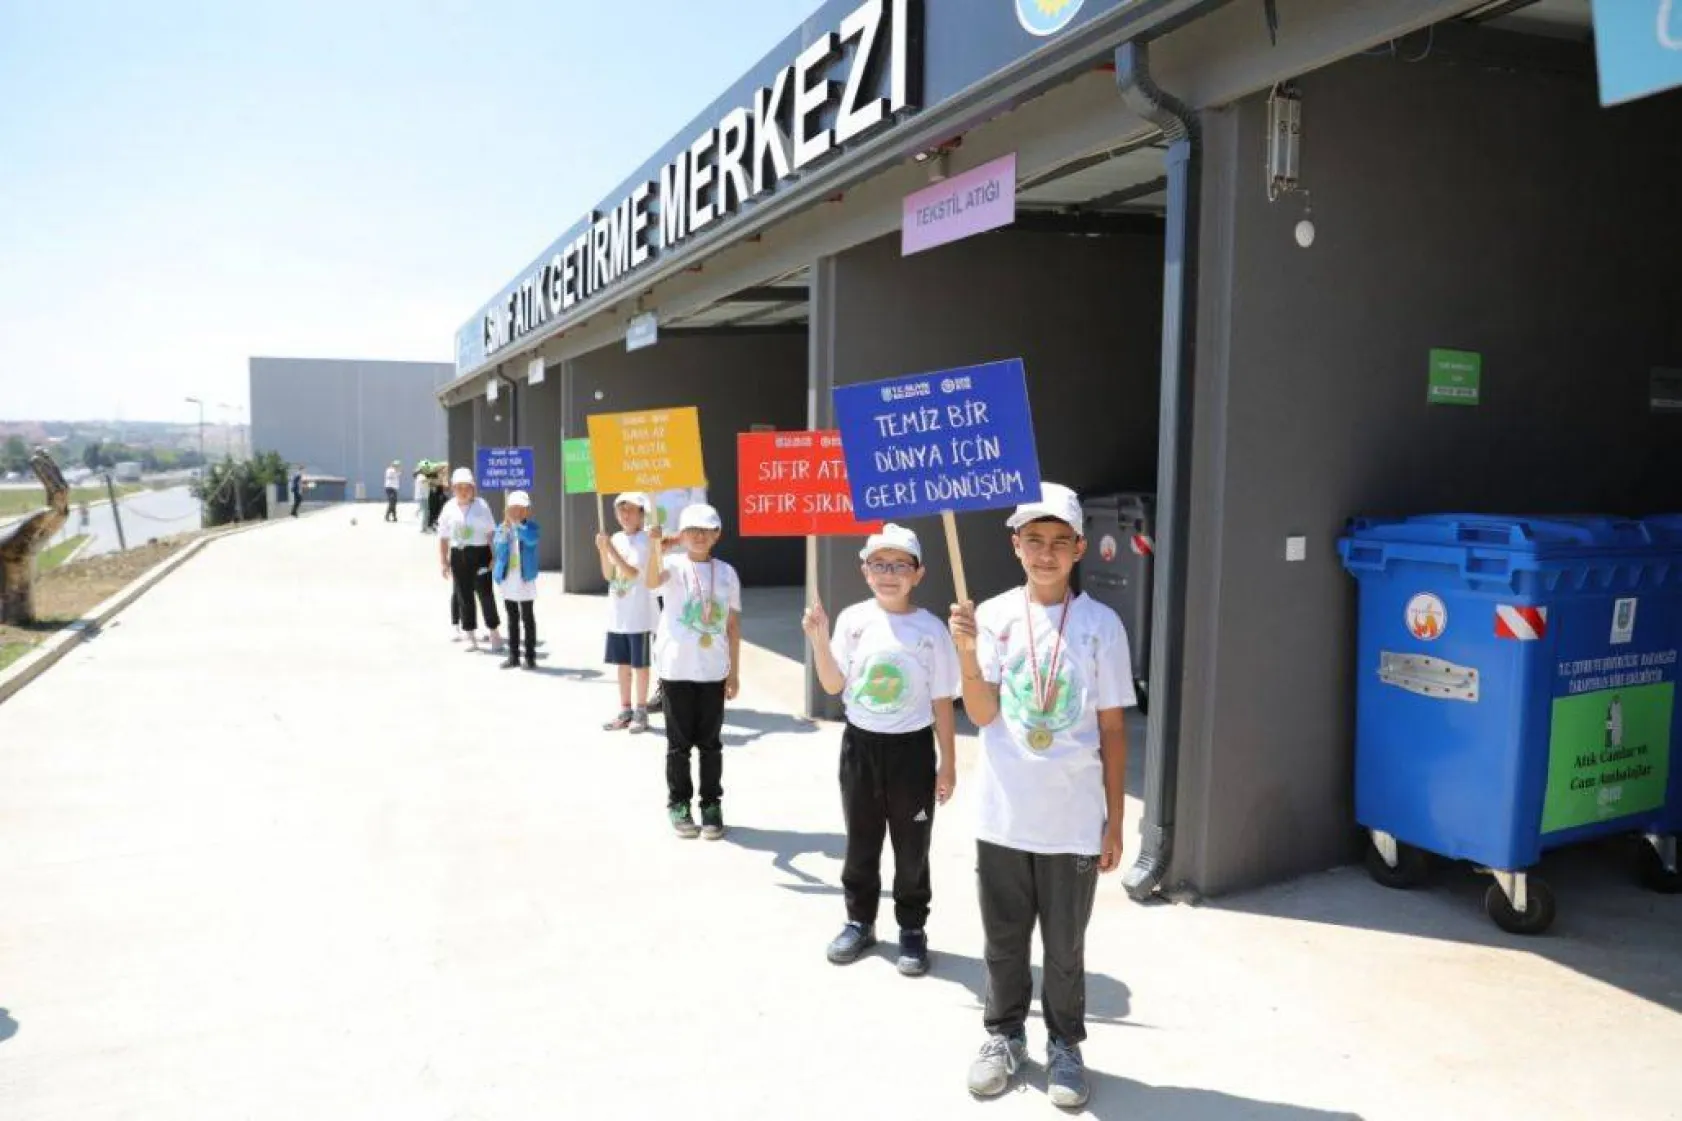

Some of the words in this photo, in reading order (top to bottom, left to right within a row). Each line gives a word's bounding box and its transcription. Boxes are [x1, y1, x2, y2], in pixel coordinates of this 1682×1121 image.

[916, 193, 962, 227] TEKSTİL
[966, 180, 1000, 210] ATIĞI
[514, 265, 547, 336] ATIK
[550, 183, 652, 315] GETİRME
[873, 406, 941, 439] TEMİZ
[947, 400, 989, 428] BİR
[758, 460, 810, 481] SIFIR
[874, 444, 943, 473] DÜNYA
[951, 434, 1001, 466] İÇİN
[744, 493, 796, 514] SIFIR
[802, 492, 854, 514] SIKIN
[865, 479, 917, 509] GERİ
[924, 468, 1025, 501] DÖNÜŞÜM
